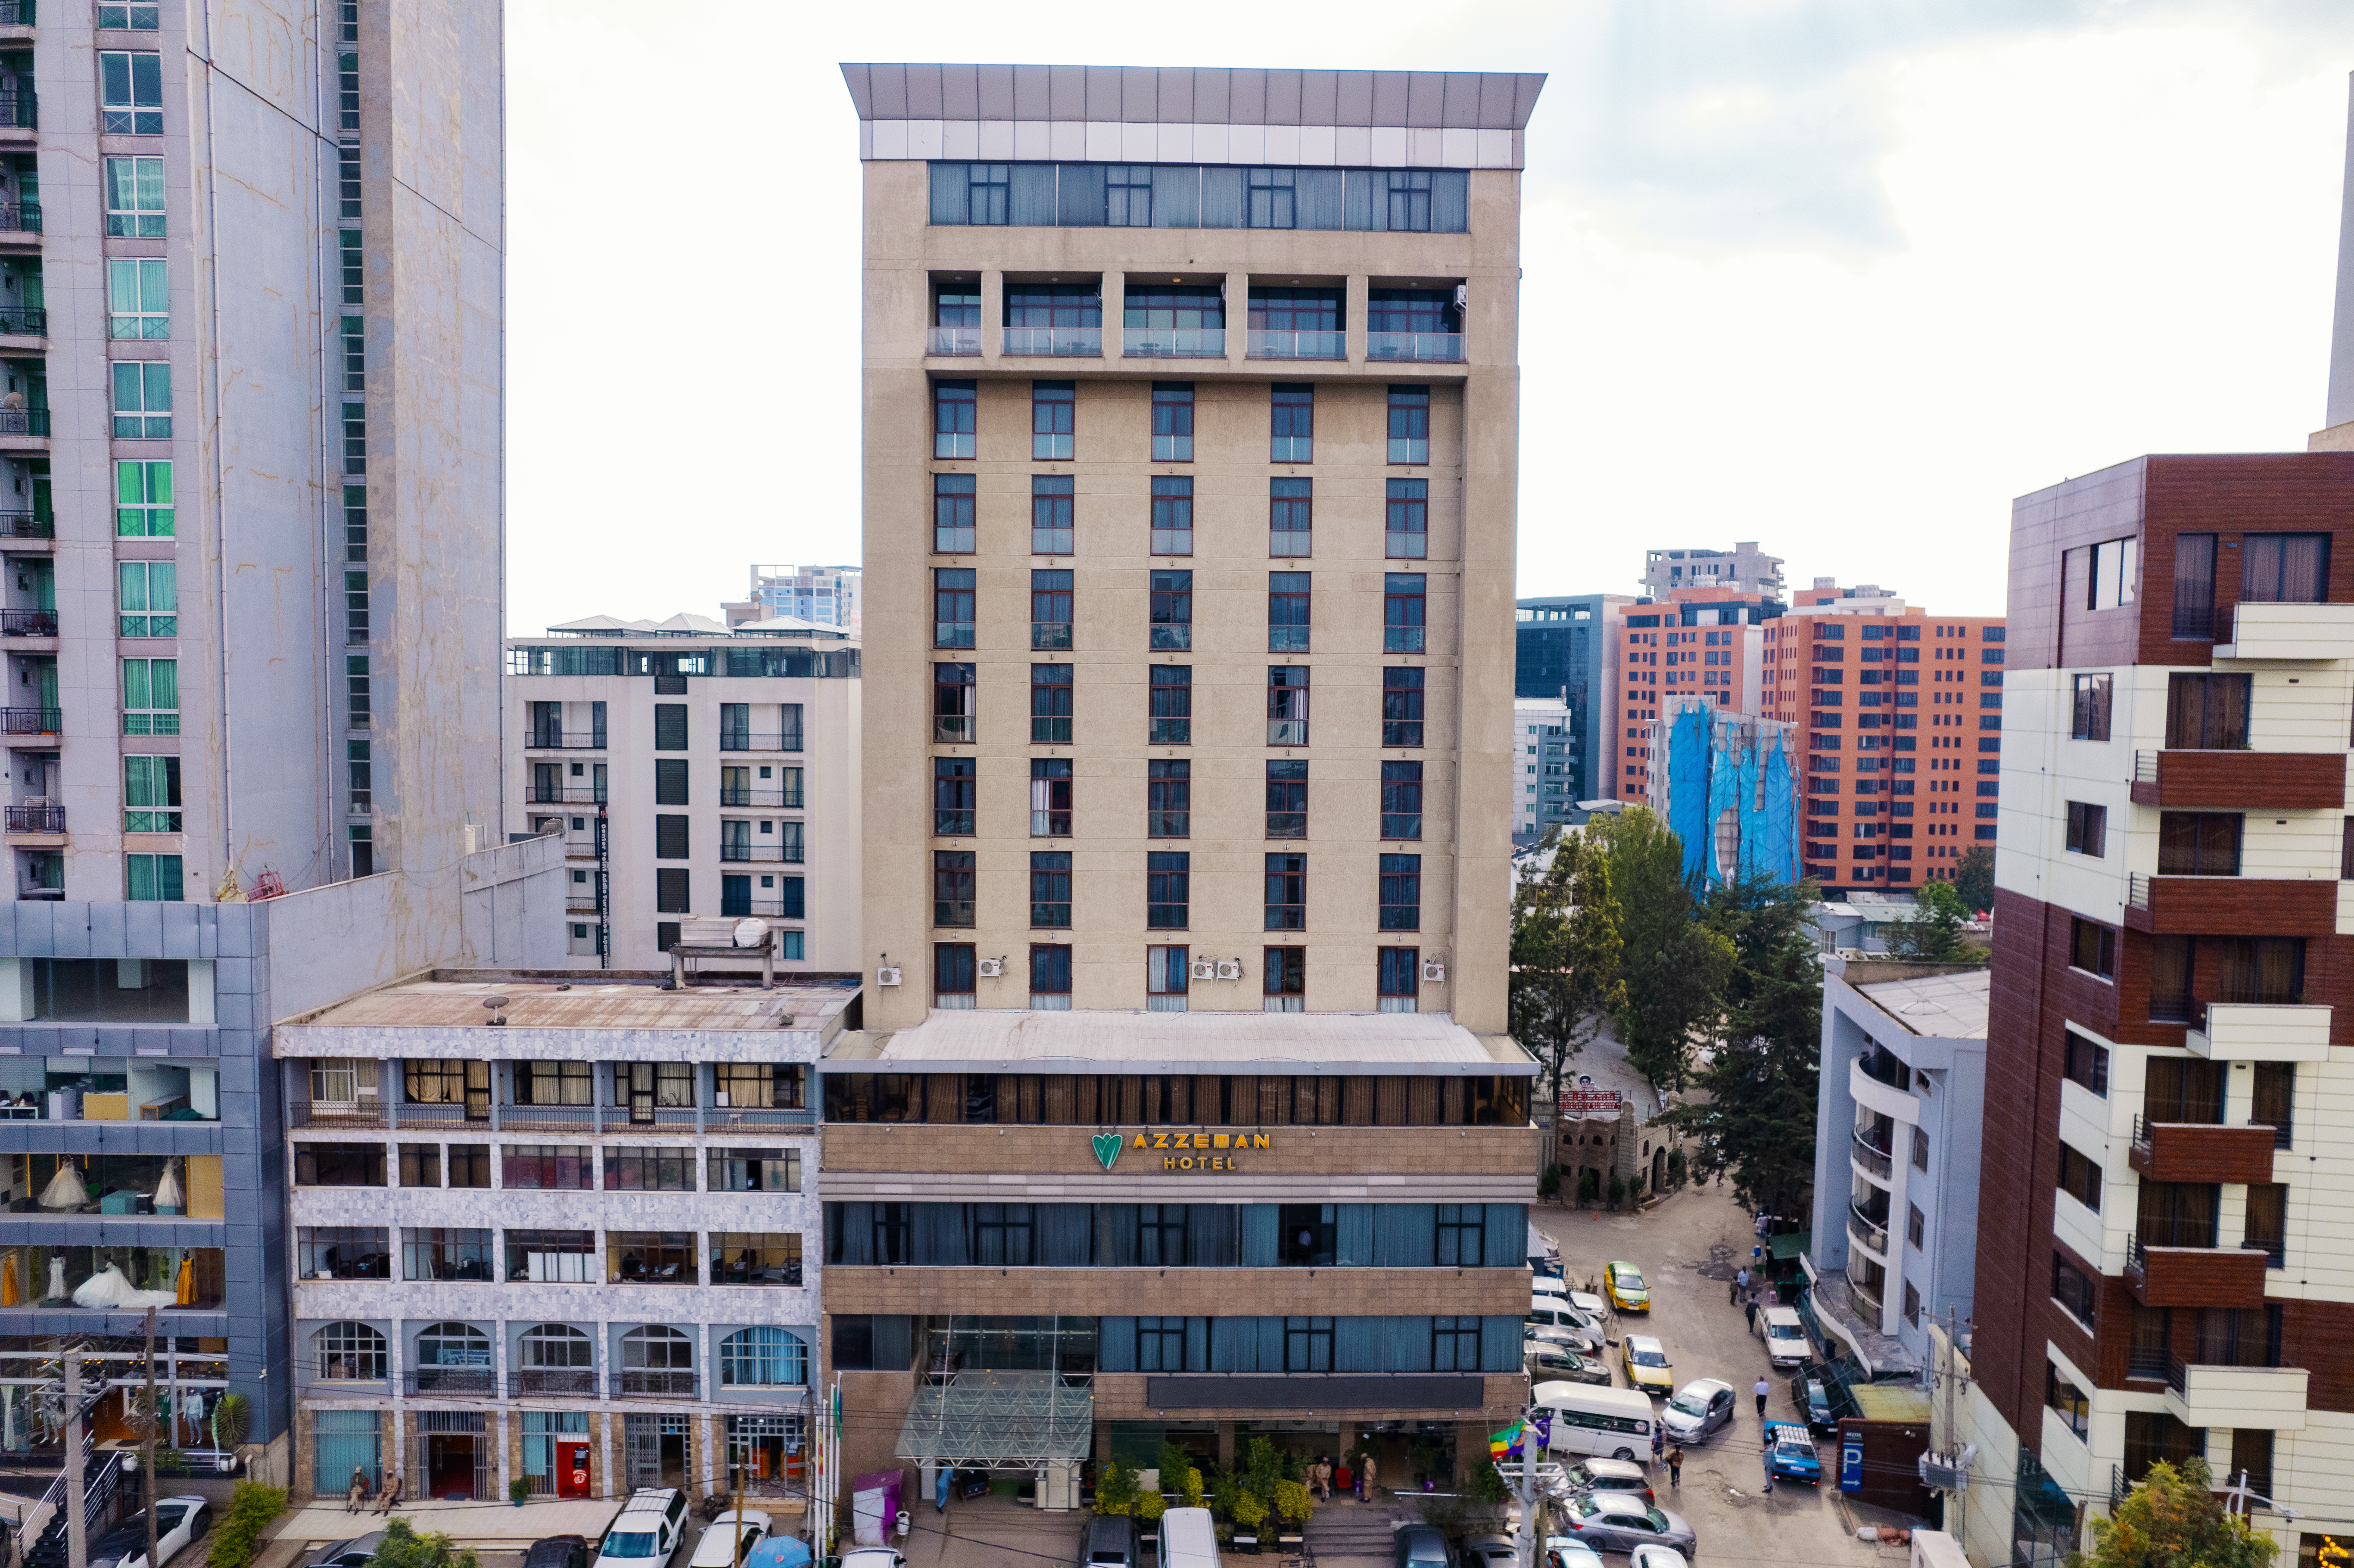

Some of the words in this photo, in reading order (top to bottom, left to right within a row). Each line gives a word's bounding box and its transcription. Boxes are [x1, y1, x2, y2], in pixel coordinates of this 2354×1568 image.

[1133, 1134, 1270, 1148] AZZEMAN
[1165, 1157, 1236, 1170] HOTEL
[1843, 1449, 1862, 1473] P
